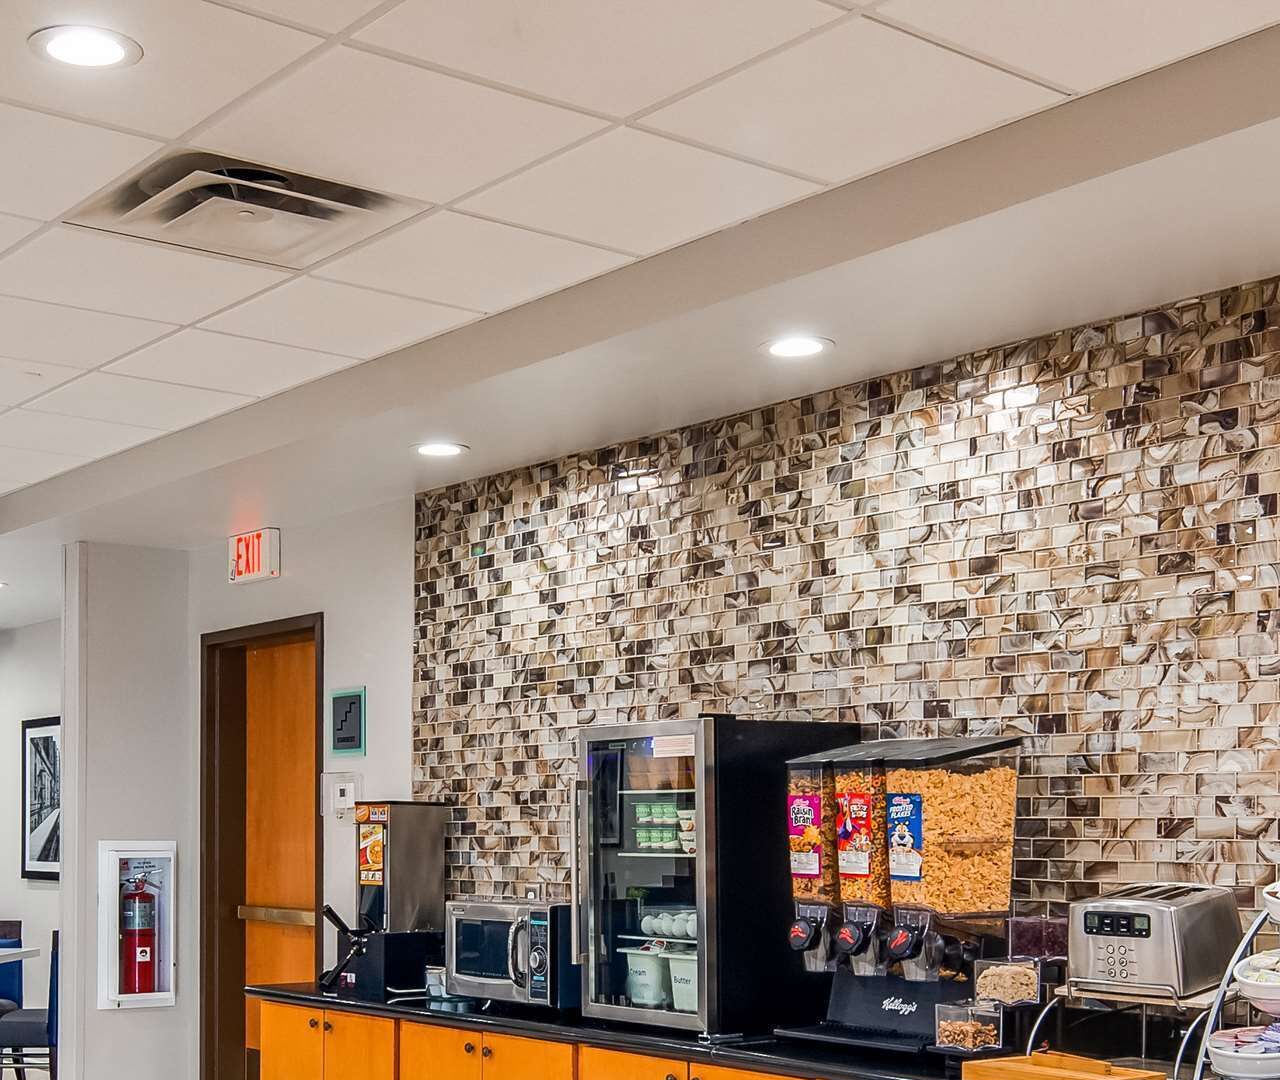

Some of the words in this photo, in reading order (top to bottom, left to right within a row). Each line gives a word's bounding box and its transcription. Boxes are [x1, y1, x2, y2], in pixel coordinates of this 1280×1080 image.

[235, 532, 262, 576] EXIT
[791, 806, 813, 817] Raisin
[794, 815, 811, 824] Bran
[673, 975, 691, 984] Butter
[881, 996, 918, 1015] Kellogg's
